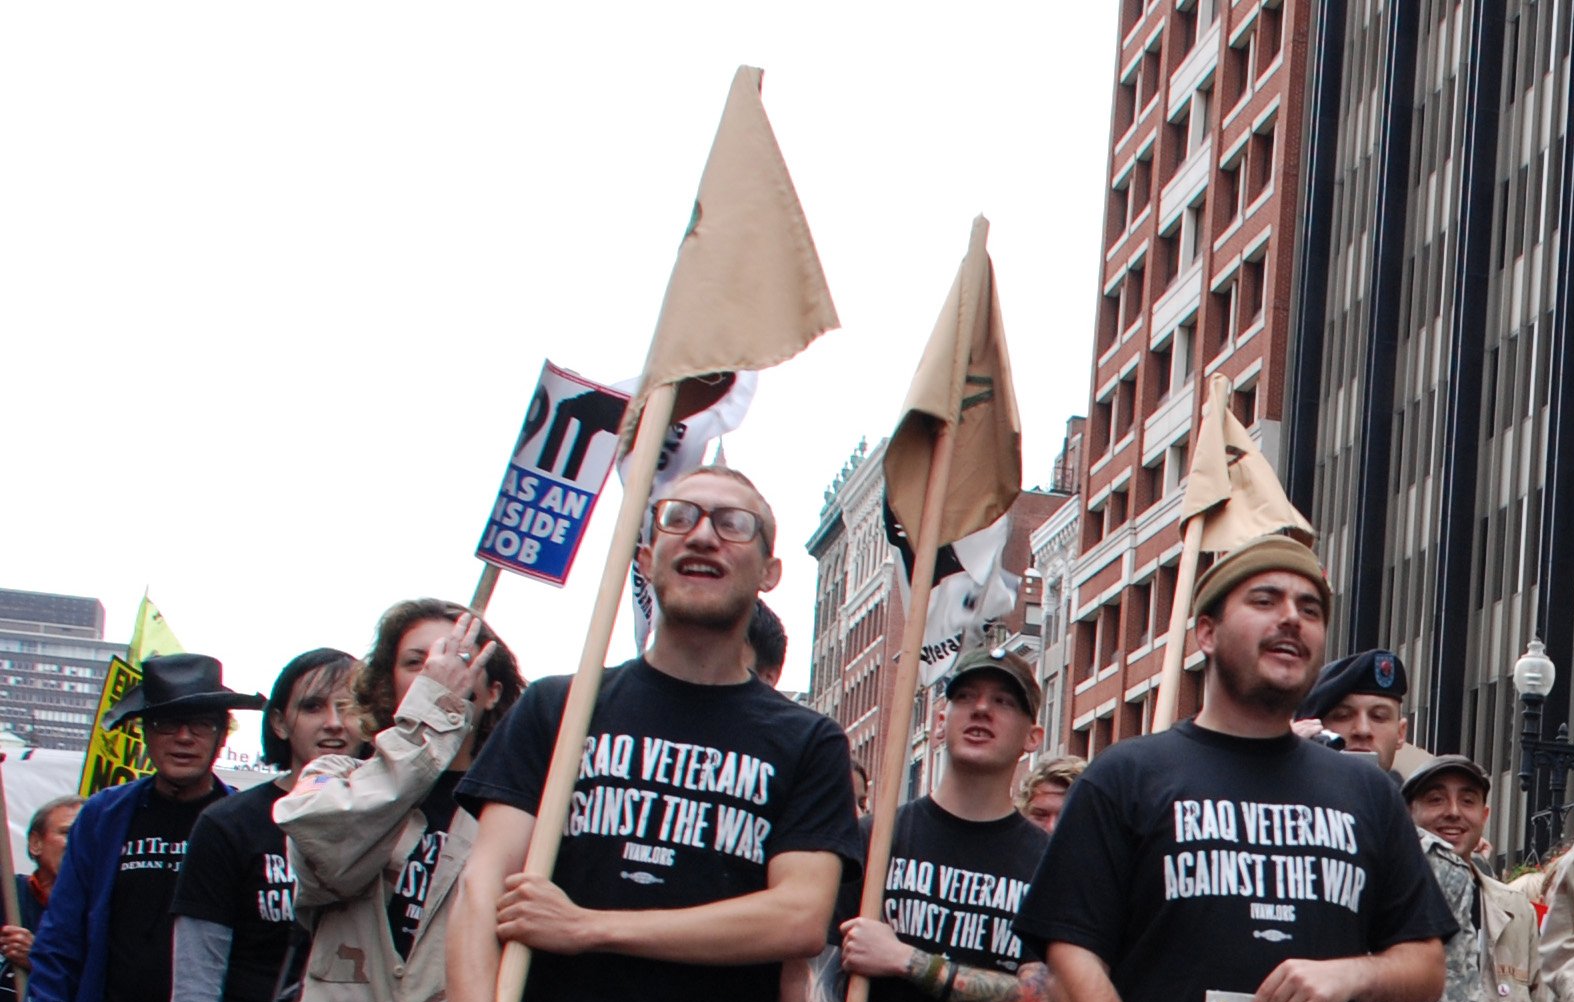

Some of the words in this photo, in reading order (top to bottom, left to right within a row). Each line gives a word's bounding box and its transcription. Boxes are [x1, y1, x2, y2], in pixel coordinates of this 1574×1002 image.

[540, 486, 588, 519] AN
[483, 524, 542, 565] JOB
[578, 733, 635, 780] RAQ
[641, 736, 775, 806] VETERANS
[658, 793, 712, 848] THE
[714, 803, 772, 865] WAR
[1173, 798, 1240, 843] IRAQ
[1240, 801, 1359, 855] VETERANS
[263, 852, 298, 884] IRA
[885, 856, 935, 897] IRAQ
[1163, 849, 1267, 901] AGAINST
[1270, 853, 1319, 900] THE
[1320, 856, 1367, 915] WAR
[884, 896, 951, 944] GAINST
[949, 910, 990, 951] THE
[989, 915, 1023, 959] WA
